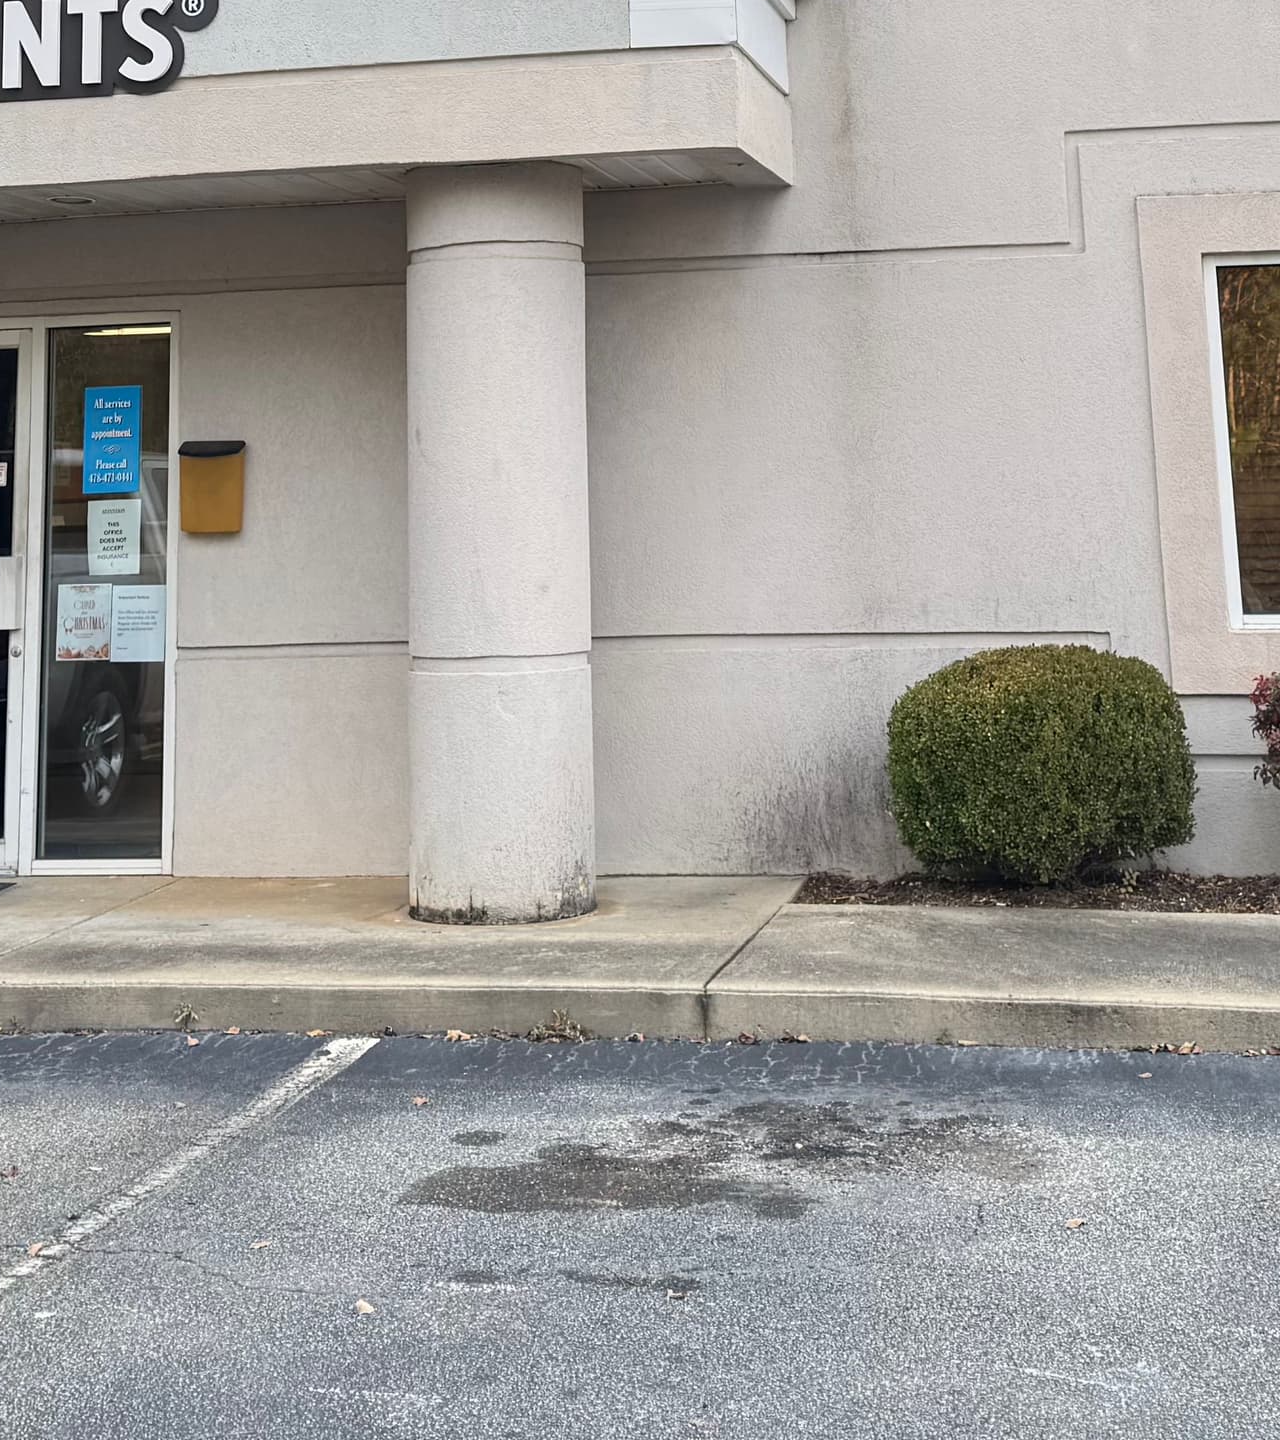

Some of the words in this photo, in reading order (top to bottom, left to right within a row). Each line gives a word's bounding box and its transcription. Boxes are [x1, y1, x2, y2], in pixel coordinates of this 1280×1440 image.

[94, 398, 104, 409] All
[104, 398, 132, 409] services
[114, 412, 123, 425] by
[95, 459, 115, 469] Please
[116, 458, 127, 469] call
